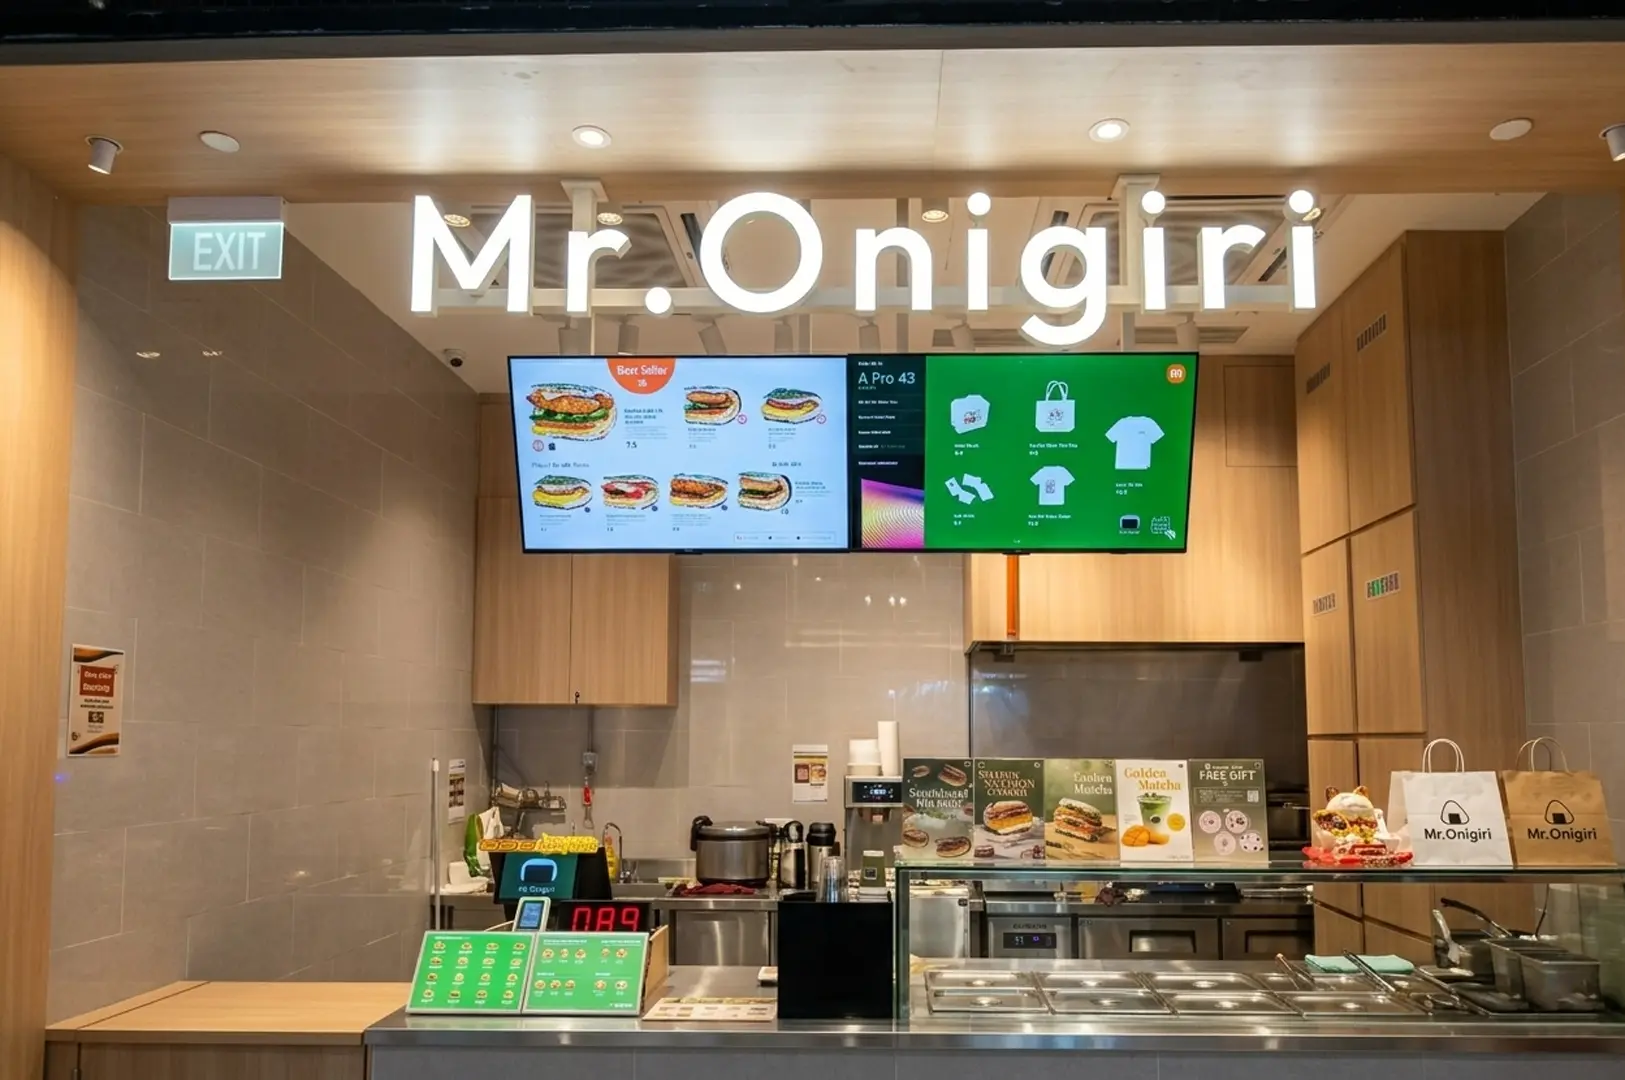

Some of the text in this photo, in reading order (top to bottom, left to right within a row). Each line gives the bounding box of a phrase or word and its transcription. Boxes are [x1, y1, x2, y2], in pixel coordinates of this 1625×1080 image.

[192, 231, 266, 271] EXIT
[858, 372, 915, 385] A Pro 43
[1229, 770, 1257, 780] GIFT
[1137, 779, 1181, 791] Matcha
[1424, 828, 1492, 842] Mr.Onigiri
[1527, 828, 1598, 842] Mr.Onigiri
